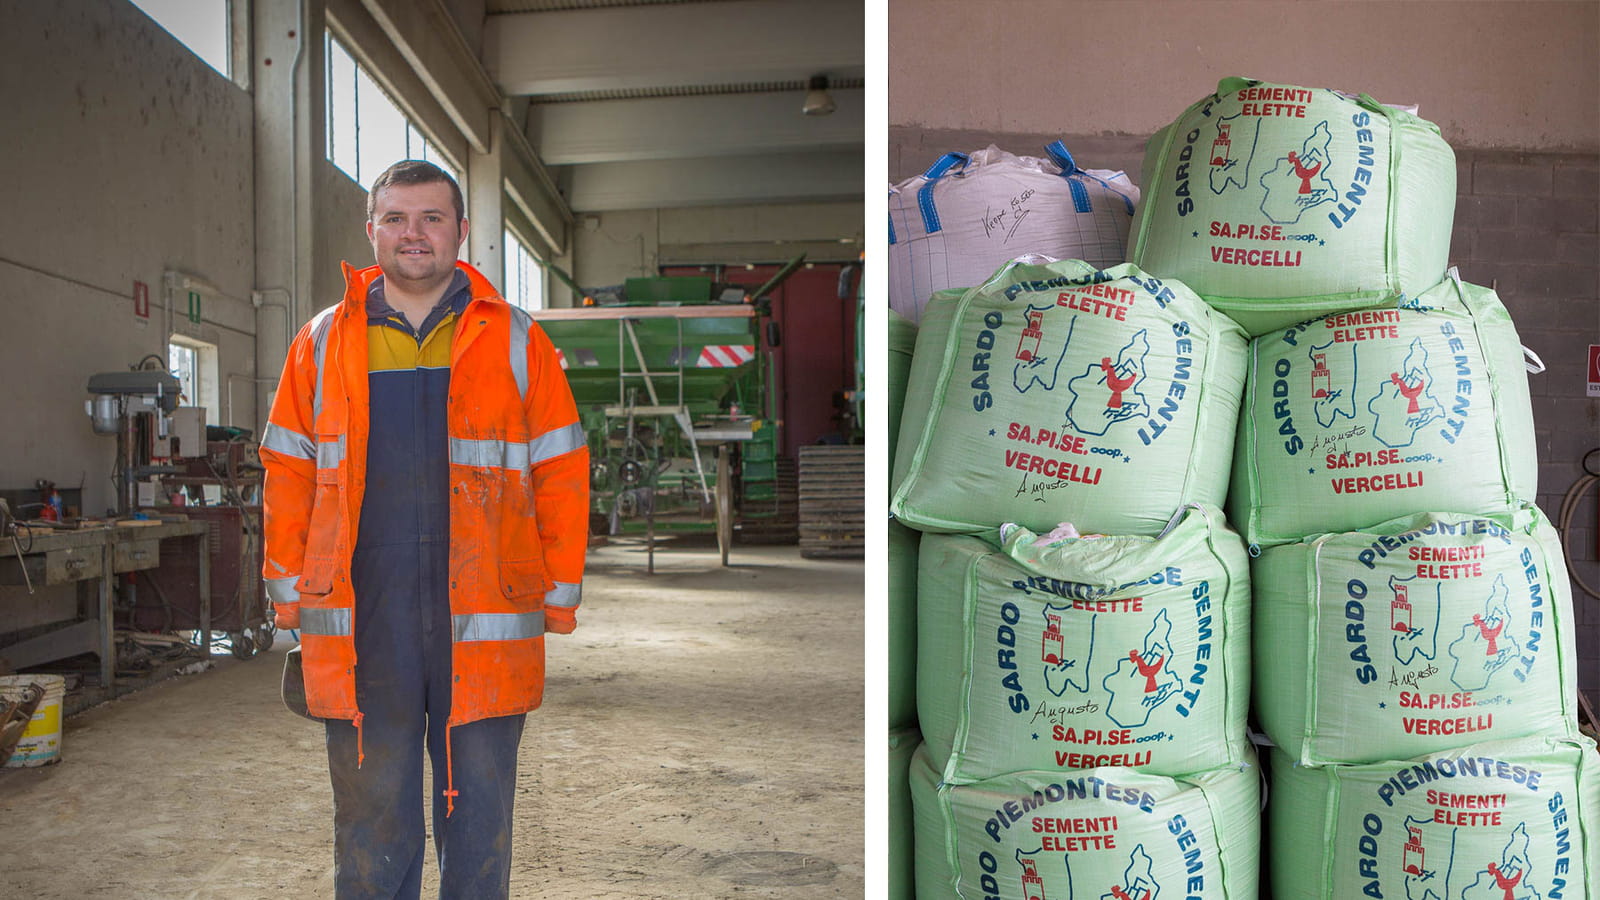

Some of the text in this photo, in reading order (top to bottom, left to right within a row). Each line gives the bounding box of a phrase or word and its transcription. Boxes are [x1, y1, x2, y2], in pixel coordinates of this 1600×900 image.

[1237, 88, 1313, 104] SEMENTI
[1243, 104, 1305, 118] ELETTE
[1176, 111, 1375, 229] SARDO SEMENTI
[1212, 247, 1301, 266] VERCELLI
[1059, 284, 1136, 305] MENTI
[1056, 293, 1128, 321] ELETTE
[1325, 311, 1400, 329] SEMENTI
[1333, 325, 1399, 343] ELETTE
[971, 312, 1003, 412] SARDO
[1137, 321, 1192, 446] SEMENTI
[1273, 321, 1473, 456] SARDO SEMENTI
[1005, 450, 1102, 485] VERCELLI
[1332, 472, 1422, 493] VERCELLI
[1408, 545, 1485, 562] SEMENTI
[1416, 563, 1482, 579] ELETTE
[1345, 579, 1378, 684] SARDO
[1513, 547, 1544, 683] SEMENTI
[997, 602, 1031, 714] SARDO
[1176, 580, 1213, 718] SEMENTI
[1403, 714, 1492, 735] VERCELLI
[1056, 751, 1151, 768] VERCELLI
[1377, 757, 1543, 807] PIEMONTESE
[1427, 790, 1506, 808] SEMENTI
[985, 777, 1156, 843] PIEMONTESE
[1434, 806, 1501, 826] ELETTE
[1033, 816, 1117, 836] SEMENTI
[1043, 835, 1115, 851] ELETTE
